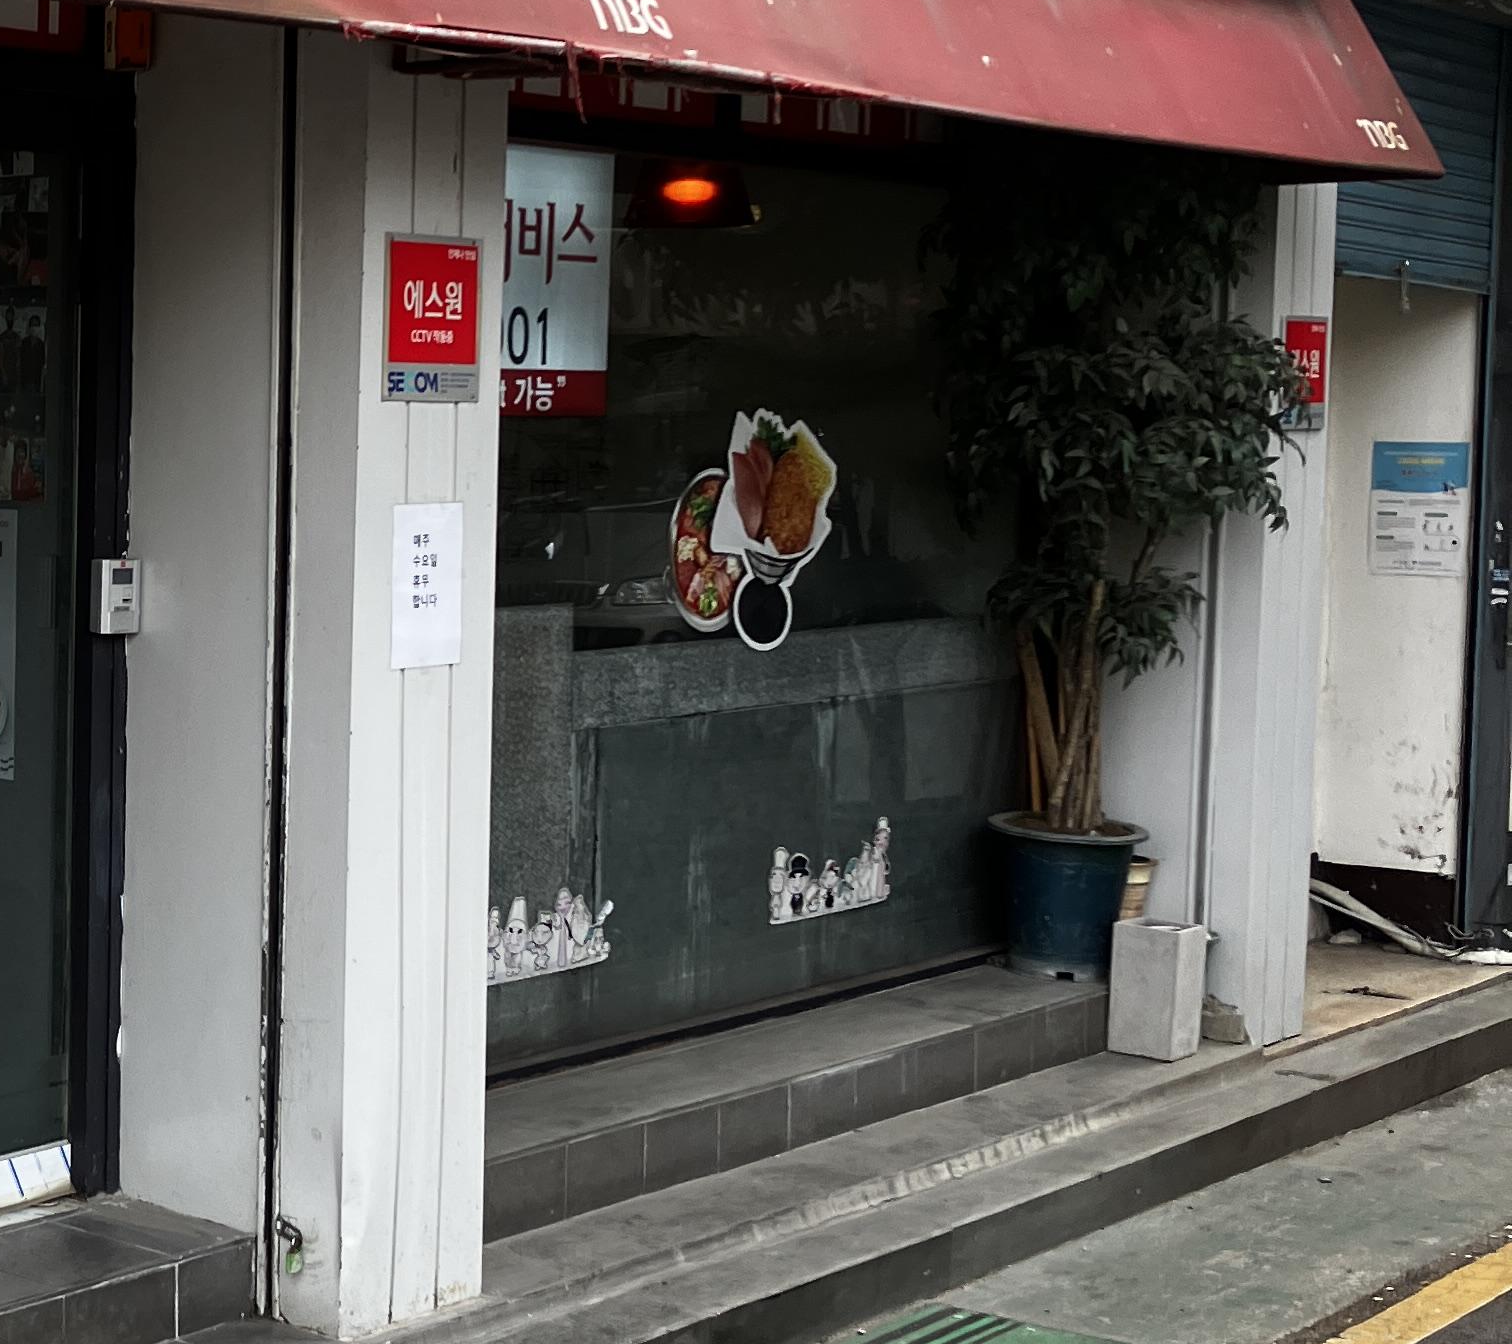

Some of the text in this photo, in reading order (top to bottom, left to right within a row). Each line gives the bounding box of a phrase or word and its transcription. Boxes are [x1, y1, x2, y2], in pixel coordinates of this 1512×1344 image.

[504, 198, 598, 285] 비스
[403, 279, 464, 321] 에스원
[410, 329, 432, 343] CCTV
[500, 306, 550, 366] 01
[387, 371, 439, 394] SECOM
